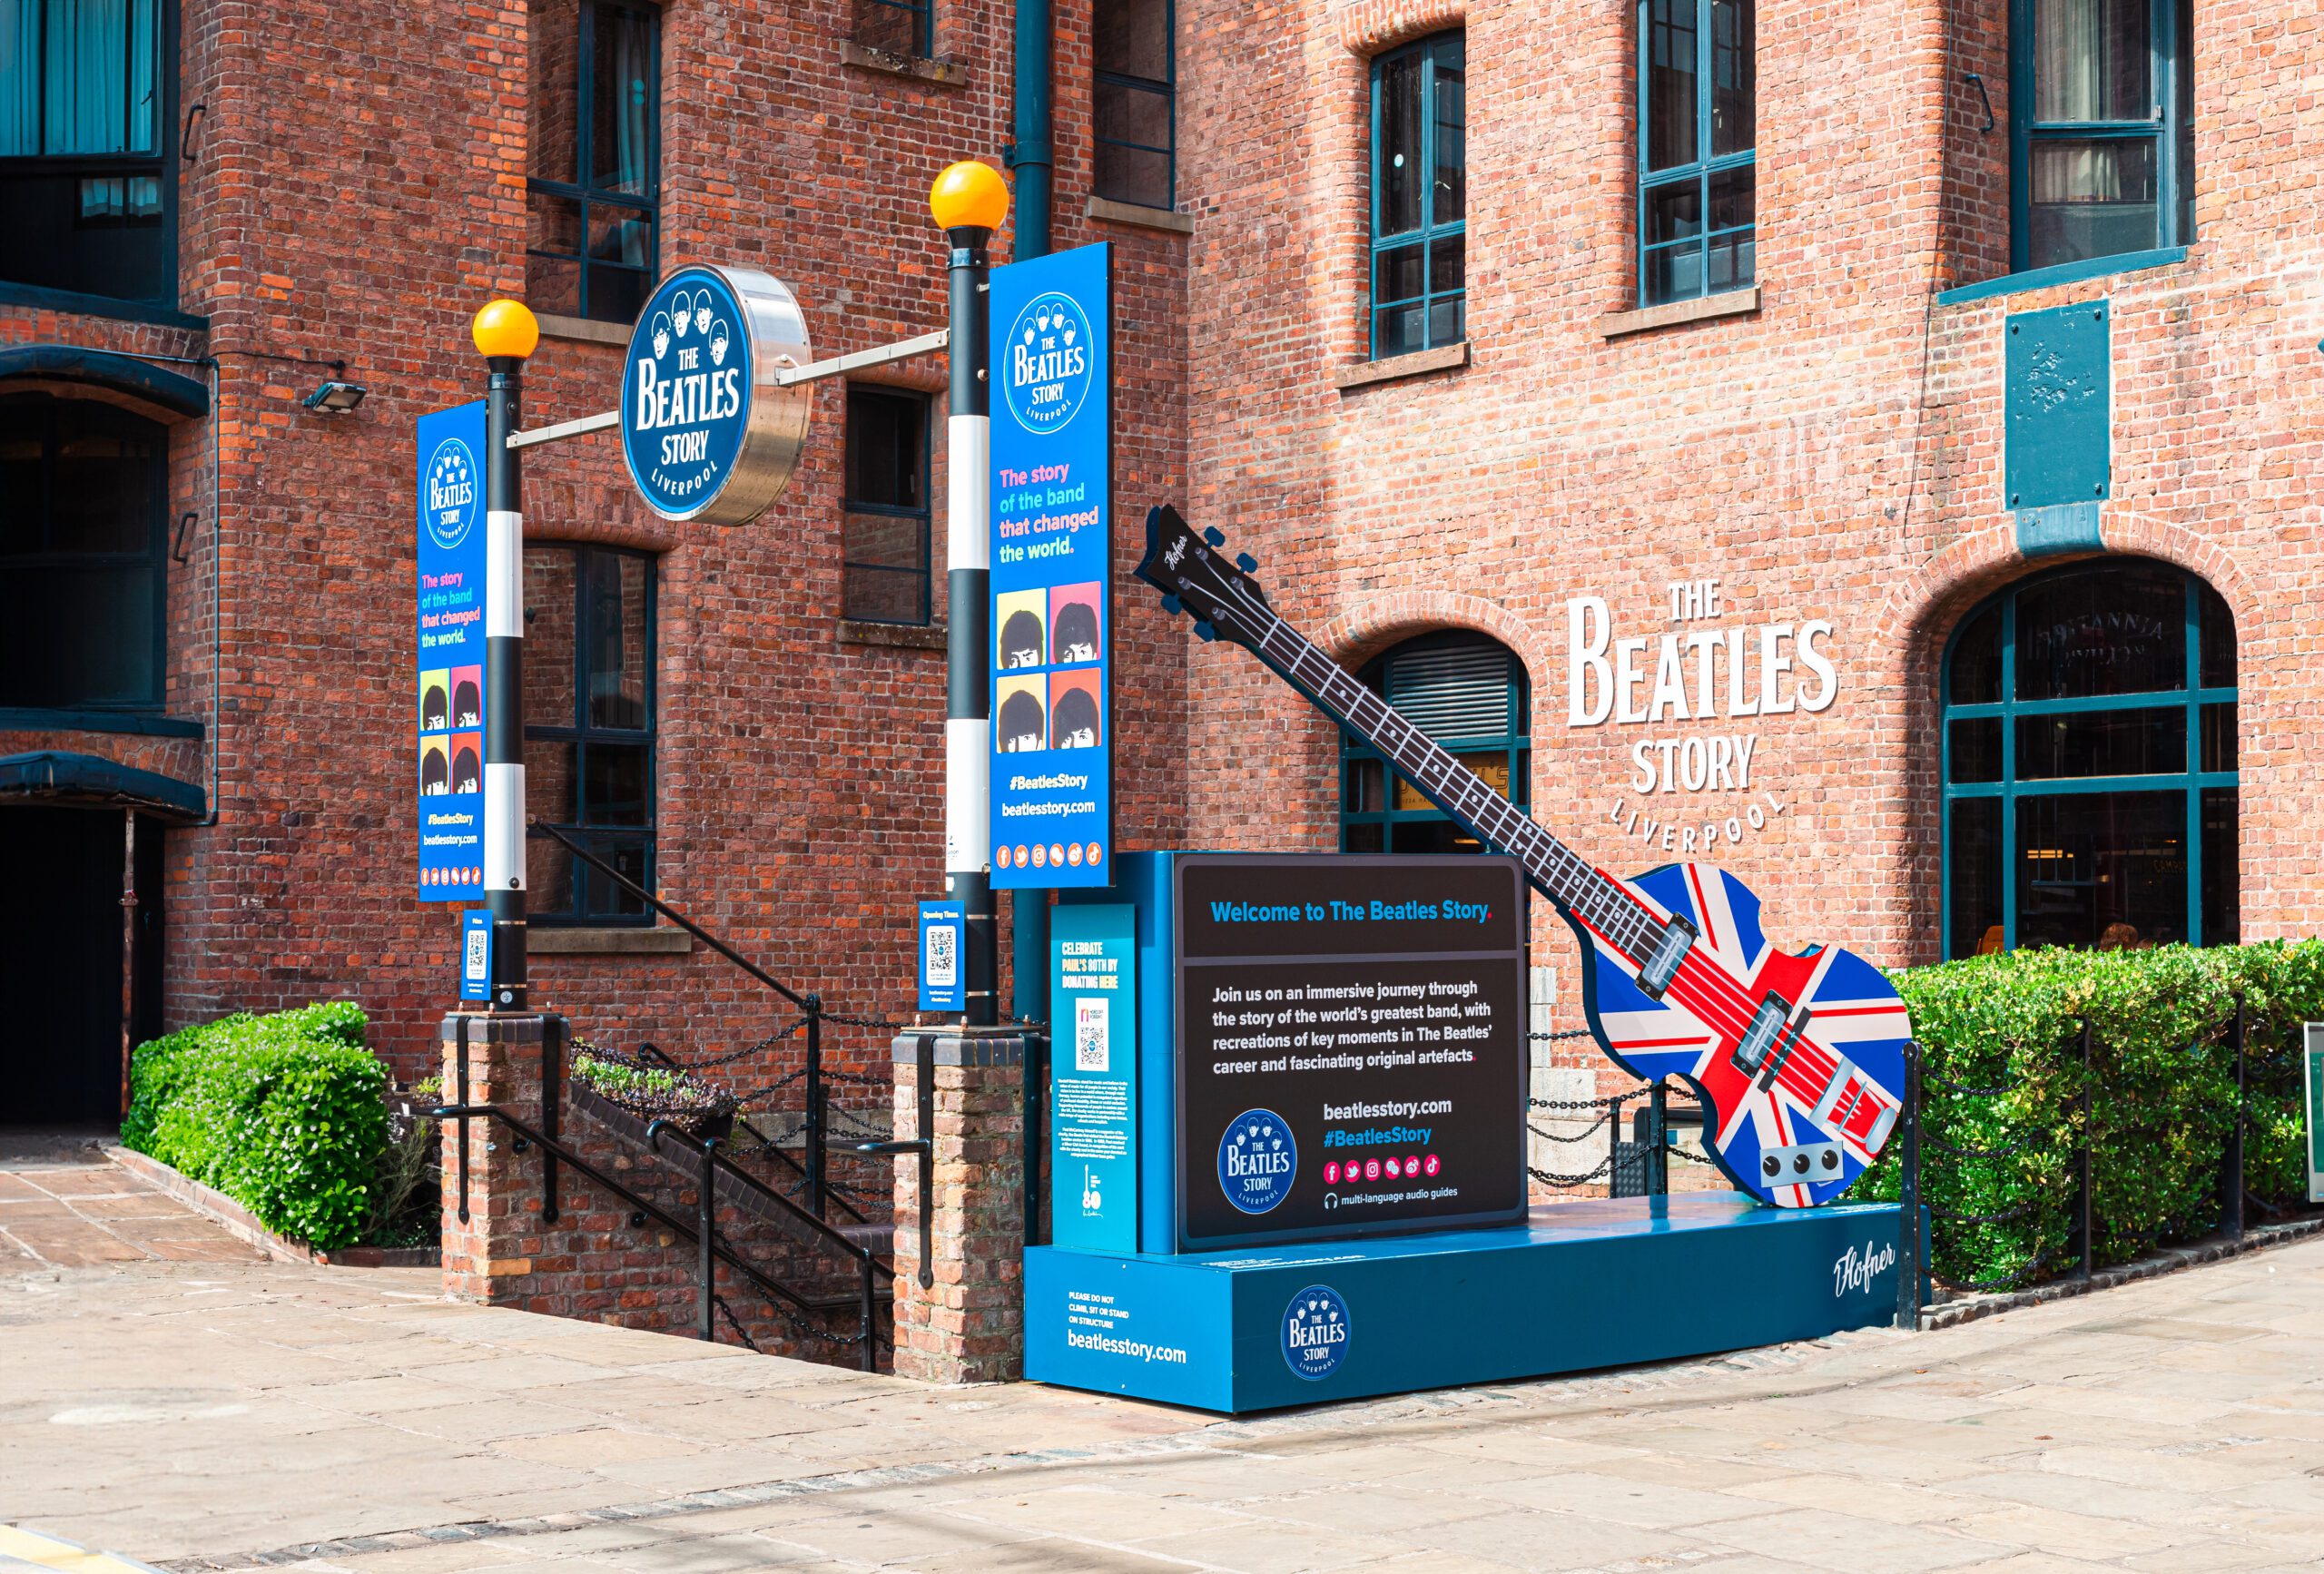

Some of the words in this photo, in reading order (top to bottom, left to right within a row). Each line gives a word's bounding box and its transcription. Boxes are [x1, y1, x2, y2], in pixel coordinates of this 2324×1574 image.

[1041, 336, 1055, 350] THE
[678, 347, 699, 370] THE
[1014, 344, 1085, 387] BEATLES
[635, 358, 740, 430] BEATLES
[1031, 382, 1065, 405] STORY
[1026, 399, 1072, 421] LIVERPOOL
[661, 430, 710, 465] STORY
[447, 472, 456, 483] THE
[652, 460, 717, 496] LIVERPOOL
[1000, 469, 1028, 488] The
[1031, 464, 1069, 484] story
[430, 477, 472, 510] BEATLES
[1000, 494, 1015, 514] of
[1019, 490, 1042, 510] the
[1048, 483, 1085, 506] band
[441, 508, 461, 525] STORY
[1000, 516, 1029, 538] that
[1034, 506, 1098, 536] changed
[438, 523, 465, 538] LIVERPOOL
[1000, 544, 1024, 565] the
[1028, 536, 1075, 559] world.
[422, 574, 438, 589] The
[440, 571, 463, 586] story
[422, 596, 432, 608] of
[432, 594, 447, 606] the
[449, 587, 472, 604] band
[1669, 579, 1721, 621] THE
[422, 614, 439, 628] that
[442, 606, 481, 626] changed
[422, 633, 436, 648] the
[438, 629, 466, 645] world.
[1567, 596, 1837, 726] BEATLES
[1632, 734, 1756, 793] STORY
[1009, 774, 1088, 791] #BeatlesStory
[428, 812, 474, 826] #BeatlesStory
[1002, 801, 1095, 817] beatlesstory.com
[1610, 792, 1785, 853] LIVERPOOL
[424, 834, 478, 848] beatlesstory.com
[1211, 900, 1300, 922] Welcome
[1305, 902, 1324, 921] to
[1329, 900, 1365, 920] The
[1370, 900, 1438, 920] Beatles
[1442, 900, 1492, 924] Story.
[1062, 942, 1102, 955] CELEBRATE
[1062, 959, 1088, 972] PAUL'S
[1088, 959, 1106, 972] 80TH
[1108, 959, 1118, 972] BY
[1062, 976, 1098, 989] DONATING
[1099, 976, 1118, 989] HERE
[1213, 987, 1242, 1002] Join
[1246, 989, 1262, 1002] us
[1265, 989, 1283, 1000] on
[1285, 988, 1303, 1000] an
[1306, 982, 1374, 999] immersive
[1377, 983, 1425, 1000] journey
[1429, 981, 1478, 998] through
[1213, 1011, 1236, 1026] the
[1239, 1011, 1274, 1028] story
[1277, 1009, 1293, 1024] of
[1295, 1008, 1316, 1024] the
[1320, 1008, 1367, 1022] world's
[1371, 1007, 1423, 1024] greatest
[1427, 1004, 1462, 1020] band,
[1464, 1003, 1491, 1018] with
[1213, 1033, 1291, 1050] recreations
[1295, 1031, 1308, 1047] of
[1311, 1031, 1334, 1048] key
[1338, 1029, 1398, 1046] moments
[1402, 1028, 1413, 1042] in
[1417, 1027, 1440, 1042] The
[1213, 1060, 1257, 1075] career
[1260, 1057, 1286, 1072] and
[1290, 1053, 1364, 1071] fascinating
[1366, 1051, 1415, 1068] original
[1418, 1048, 1476, 1064] artefacts.
[1324, 1100, 1452, 1121] beatlesstory.com
[1252, 1142, 1265, 1152] THE
[1324, 1126, 1432, 1148] #BeatlesStory
[1227, 1145, 1289, 1177] BEATLES
[1244, 1177, 1273, 1191] STORY
[1238, 1189, 1279, 1205] LIVERPOOL
[1341, 1192, 1403, 1205] multi-language
[1405, 1189, 1429, 1201] audio
[1431, 1187, 1458, 1201] guides
[1069, 1292, 1089, 1302] PLEASE
[1091, 1294, 1100, 1303] DO
[1101, 1295, 1114, 1303] NOT
[1069, 1304, 1088, 1314] CLIMB,
[1089, 1306, 1098, 1314] SIT
[1099, 1307, 1108, 1316] OR
[1109, 1309, 1129, 1318] STAND
[1312, 1314, 1322, 1323] THE
[1069, 1316, 1078, 1325] ON
[1078, 1318, 1114, 1329] STRUCTURE
[1289, 1319, 1345, 1347] BEATLES
[1068, 1329, 1187, 1363] beatlesstory.com
[1304, 1347, 1329, 1361] STORY
[1299, 1358, 1334, 1372] LIVERPOOL
